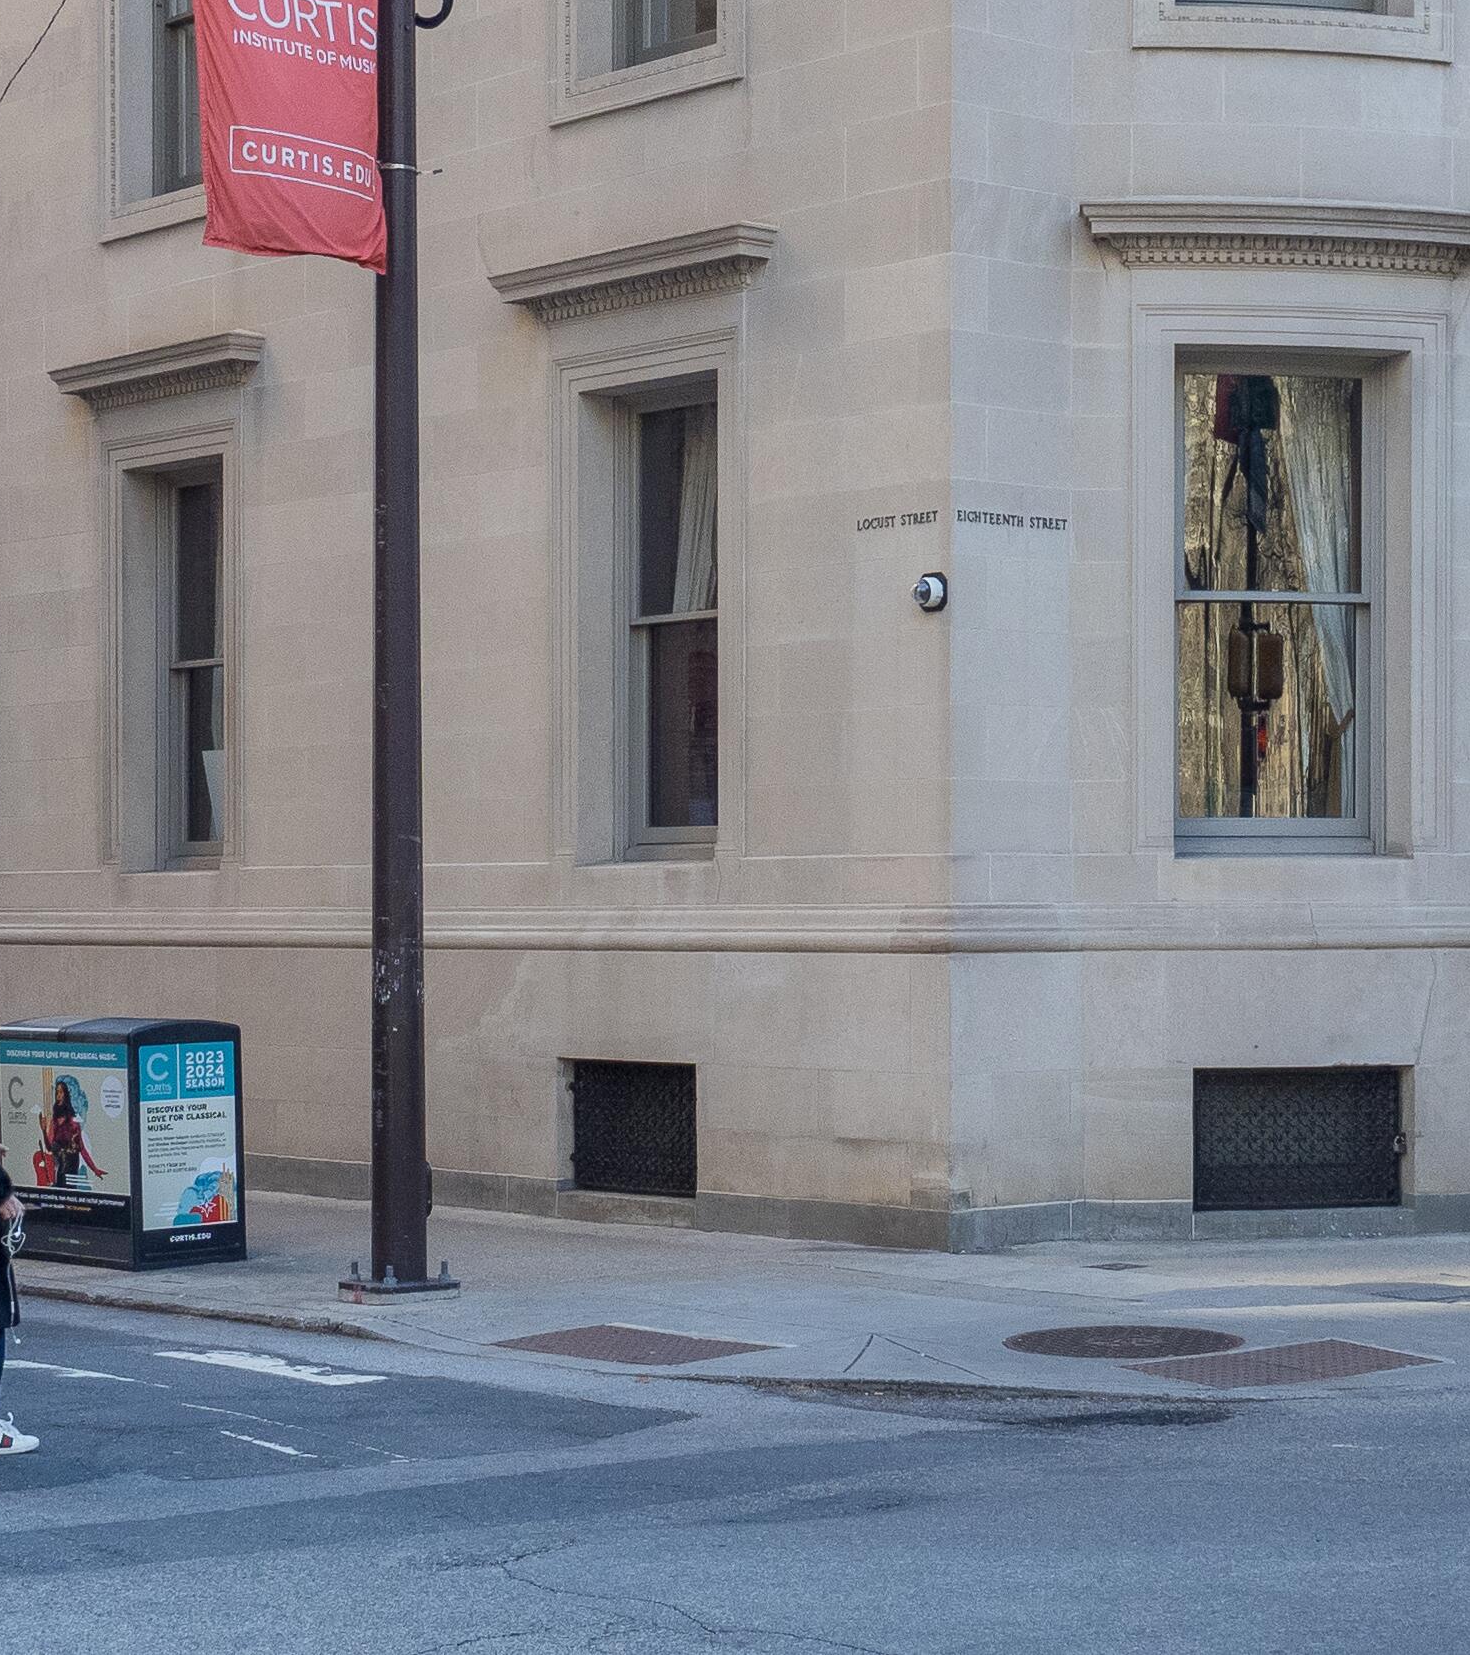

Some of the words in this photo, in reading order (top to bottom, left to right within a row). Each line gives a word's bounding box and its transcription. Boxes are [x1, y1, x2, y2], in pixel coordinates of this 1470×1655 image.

[233, 29, 314, 61] INSTITUTE
[317, 49, 337, 66] OF
[242, 141, 372, 187] CURTIS.EDU
[857, 515, 896, 531] LOCUST
[900, 510, 938, 526] STREET
[957, 509, 1024, 528] EIGHTEENTH
[1029, 516, 1068, 530] STREET
[185, 1050, 225, 1065] 2023
[185, 1064, 225, 1078] 2024
[185, 1076, 225, 1089] SEASON
[147, 1105, 185, 1114] DISCOVER
[188, 1103, 208, 1112] YOUR
[147, 1115, 167, 1123] LOVE
[186, 1111, 227, 1120] CLASSICAL
[147, 1123, 174, 1132] MUSIC.
[169, 1232, 212, 1243] CURTIS.EDU
